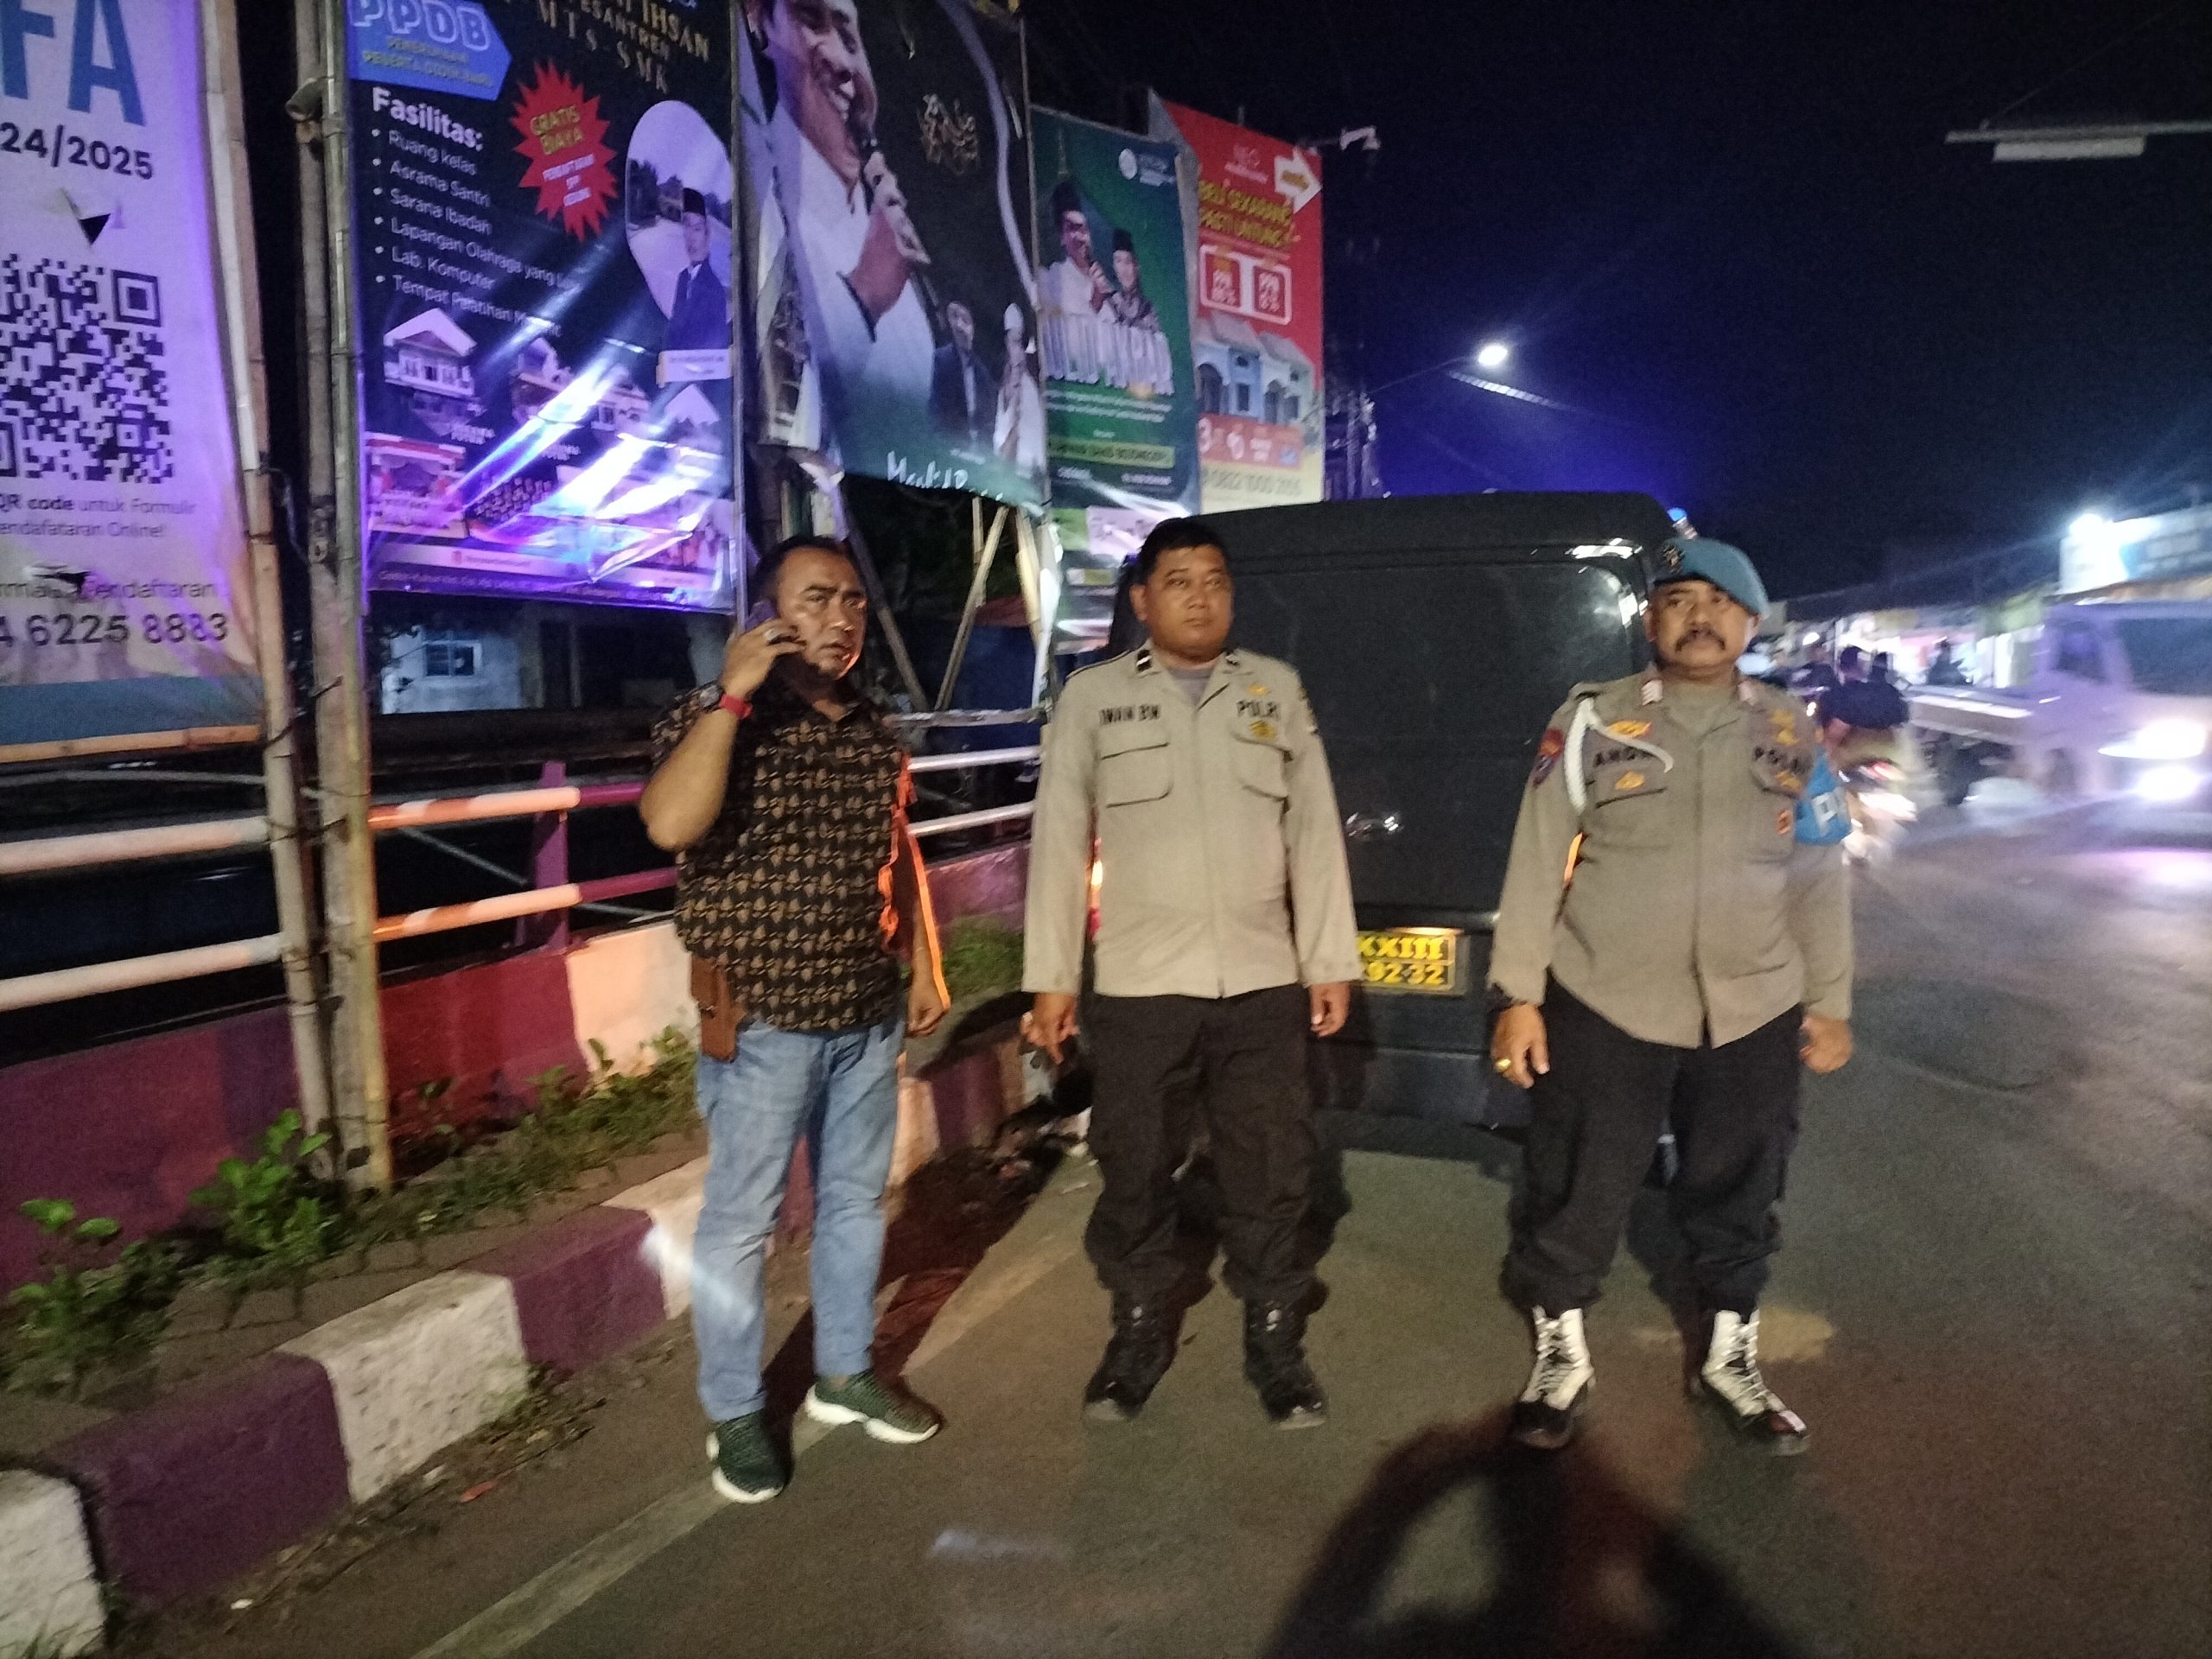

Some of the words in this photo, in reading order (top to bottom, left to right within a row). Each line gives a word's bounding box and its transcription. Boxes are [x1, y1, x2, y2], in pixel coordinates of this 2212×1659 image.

[346, 0, 490, 51] PPDB
[372, 86, 484, 151] Fasilitas:
[1, 122, 154, 180] 24/2025
[390, 188, 443, 219] Sarana
[28, 495, 75, 510] code
[26, 613, 130, 646] 6225
